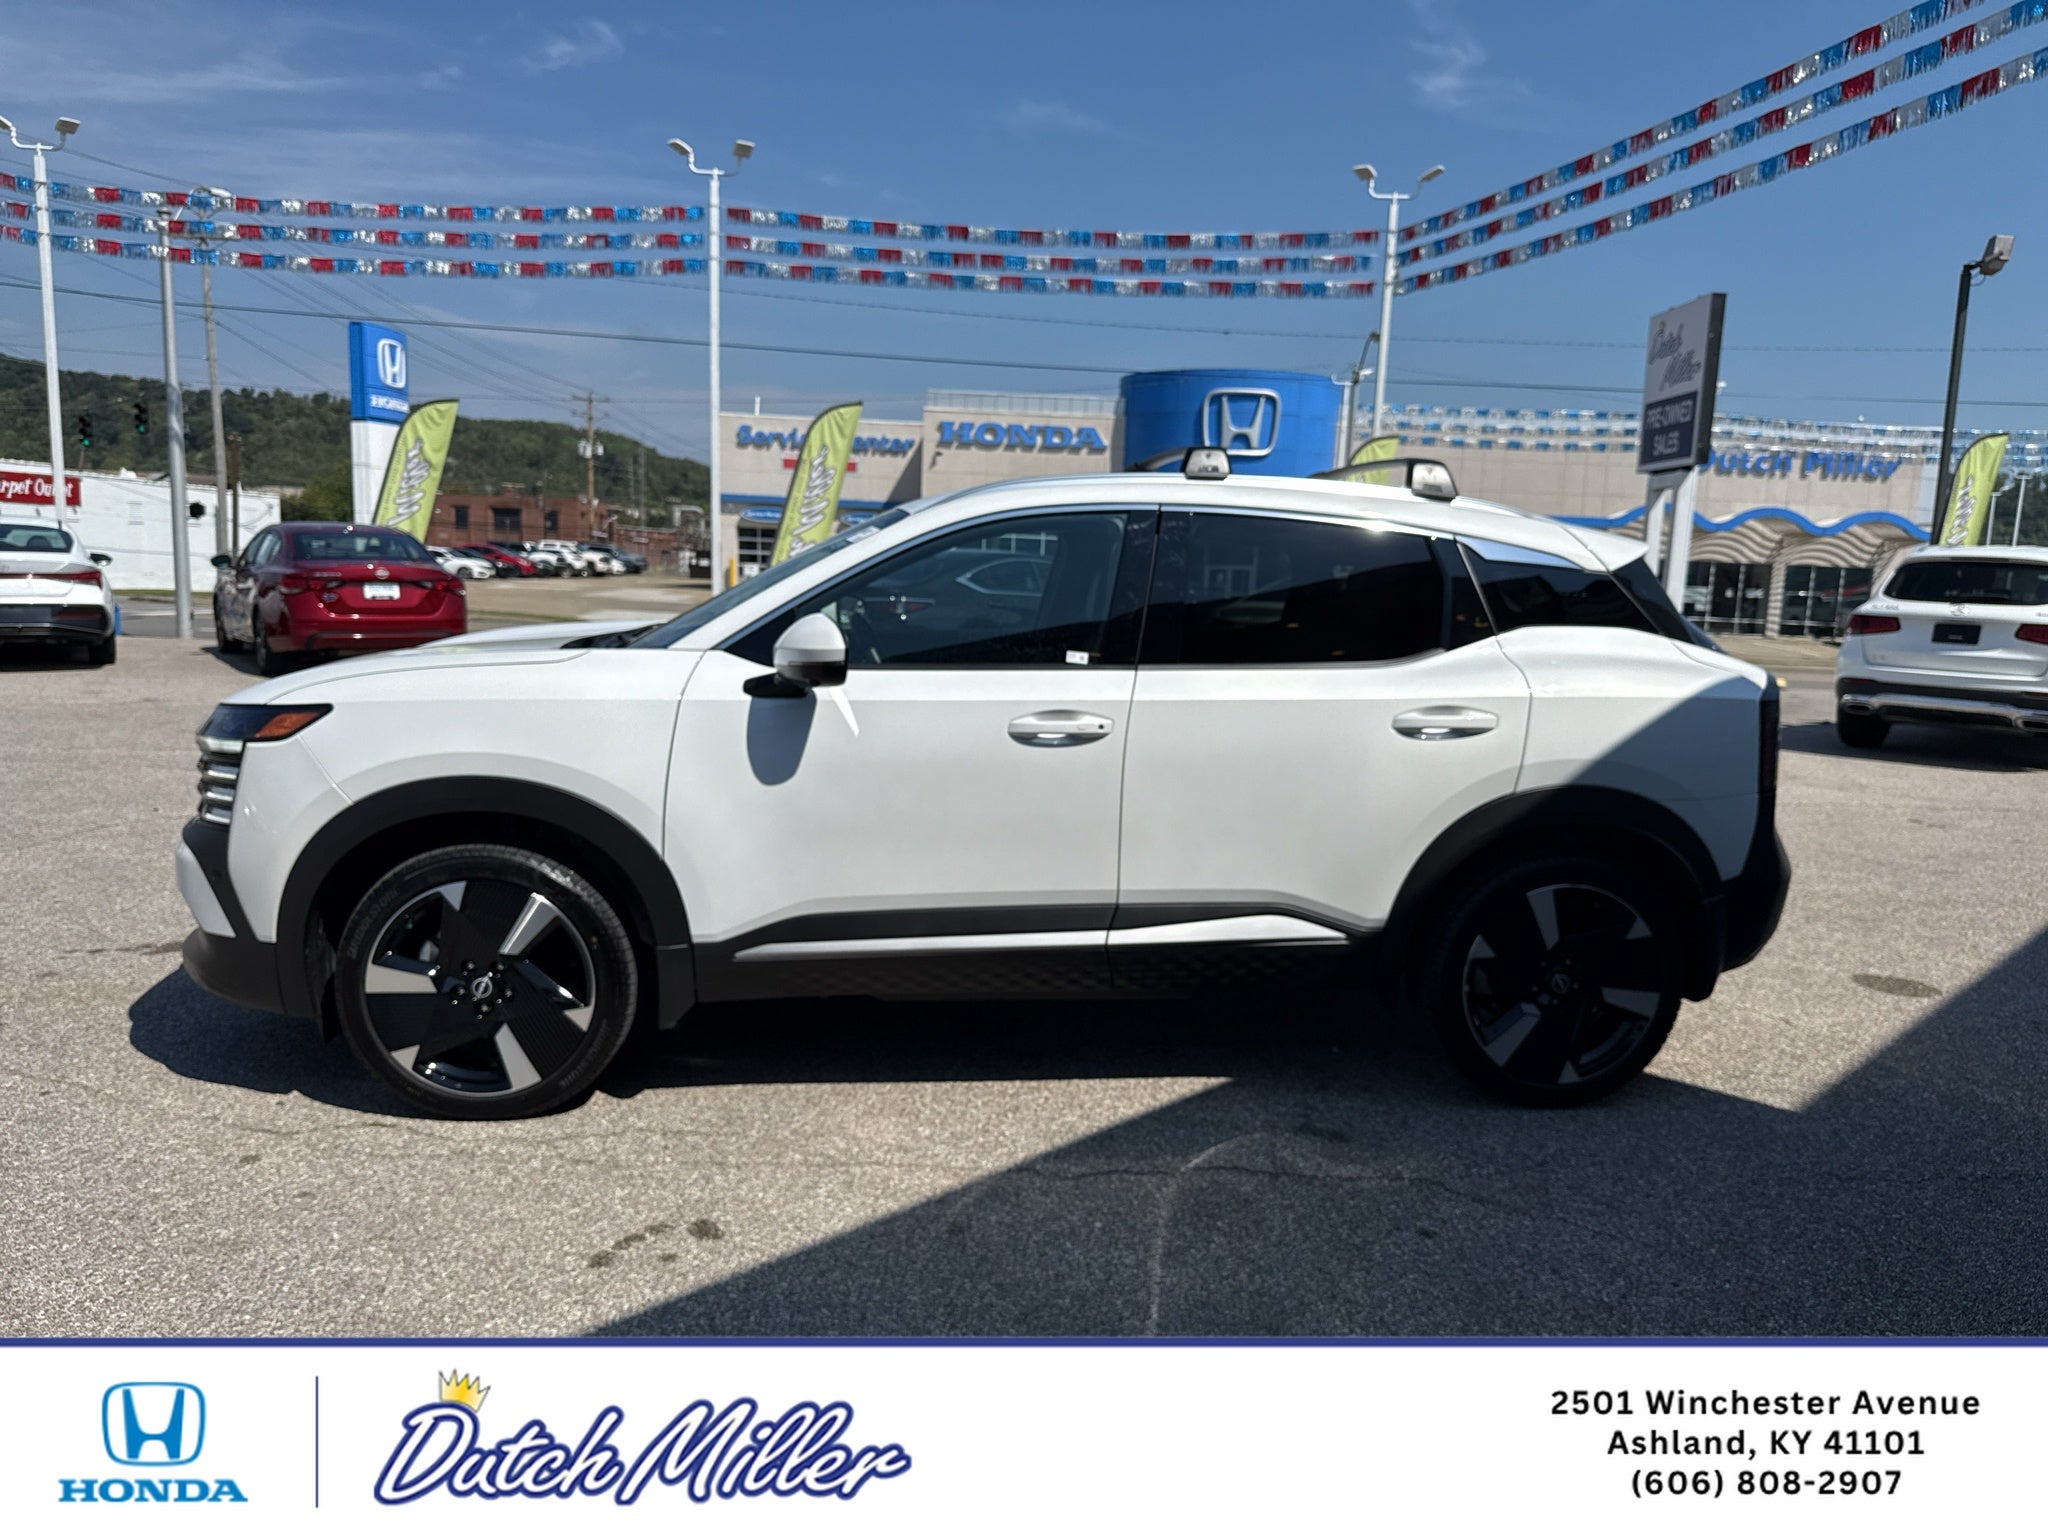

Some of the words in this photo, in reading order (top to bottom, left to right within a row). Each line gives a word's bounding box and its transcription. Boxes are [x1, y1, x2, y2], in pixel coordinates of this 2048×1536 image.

[1645, 399, 1693, 430] PRE-OWNED
[737, 424, 806, 445] Servi
[851, 435, 915, 451] enter
[938, 421, 1107, 450] HONDA
[1653, 431, 1680, 457] SALES
[1805, 450, 1901, 477] Miller
[0, 477, 33, 498] rpet
[33, 478, 74, 498] Out
